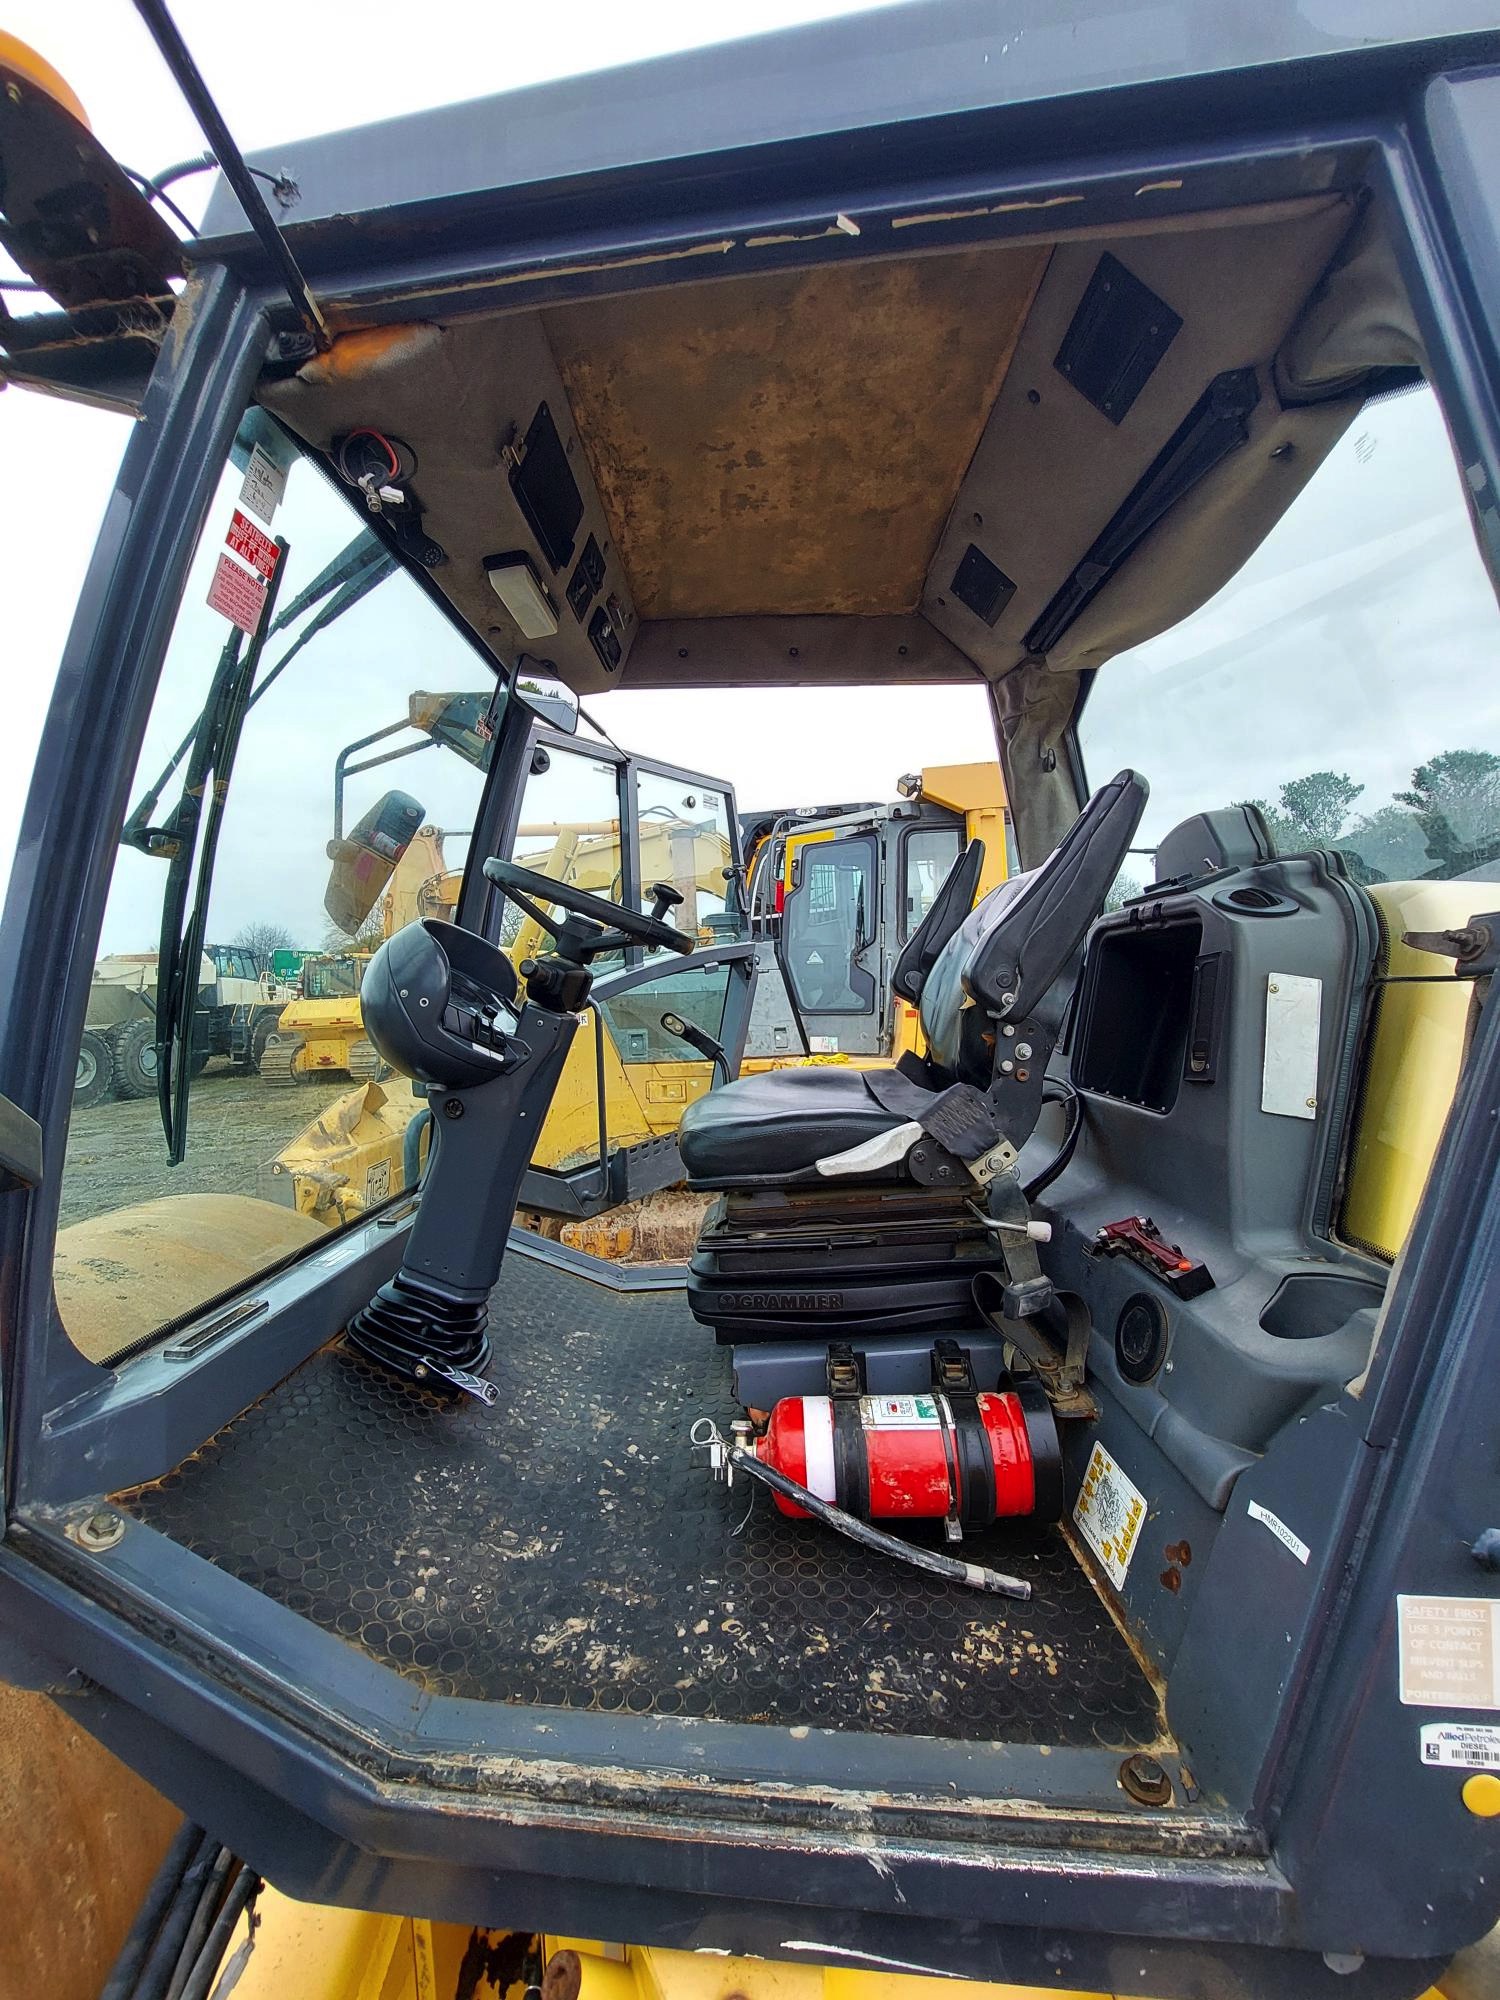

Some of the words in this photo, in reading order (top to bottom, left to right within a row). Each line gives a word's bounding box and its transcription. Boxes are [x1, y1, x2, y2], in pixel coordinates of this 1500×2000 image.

[230, 522, 248, 544] MUST
[248, 538, 257, 551] BE
[240, 518, 272, 552] SEATBELTS
[230, 535, 239, 549] AT
[240, 544, 251, 559] ALL
[251, 554, 269, 574] TIMES
[224, 558, 246, 579] PLEASE
[247, 577, 263, 592] NOTE!
[740, 1294, 842, 1310] GRAMMER
[1261, 1511, 1300, 1552] HMR1022U1
[1406, 1606, 1448, 1616] SAFETY
[1454, 1608, 1485, 1618] FIRST
[1408, 1624, 1428, 1634] USE
[1433, 1624, 1440, 1634] 3
[1444, 1626, 1483, 1636] POINTS
[1410, 1639, 1424, 1648] OF
[1430, 1641, 1482, 1651] CONTACT
[1421, 1670, 1444, 1679] AND
